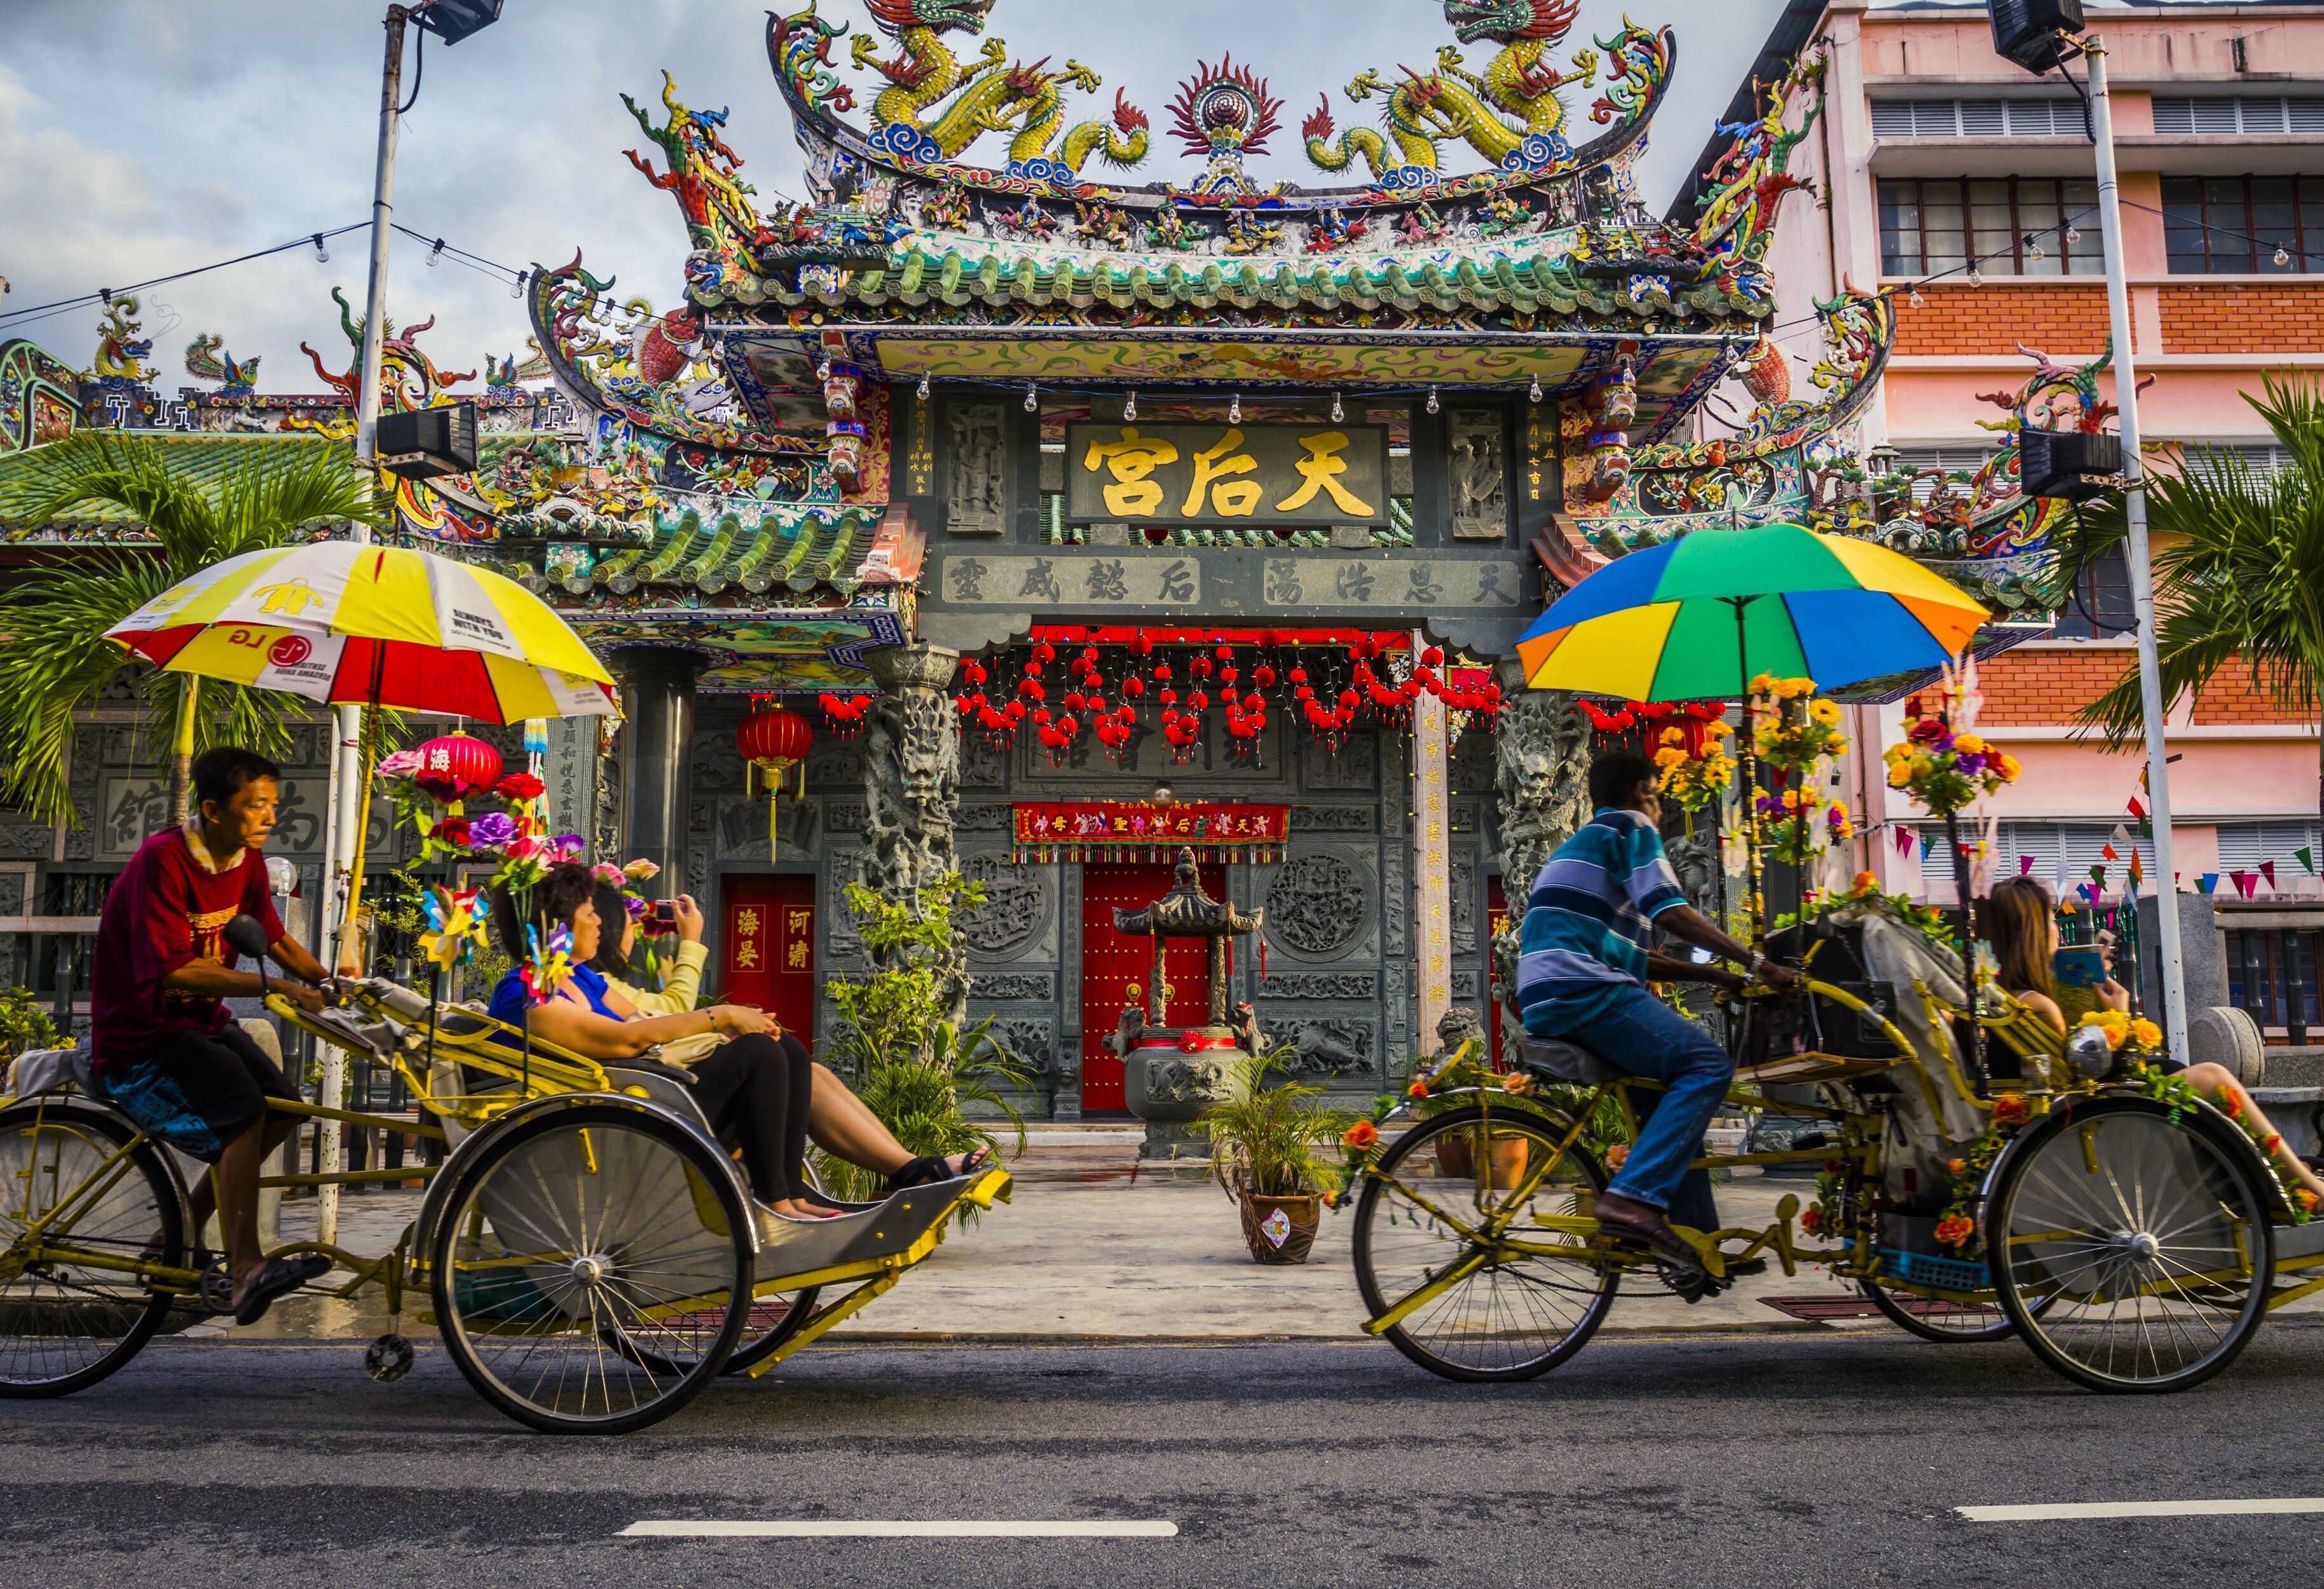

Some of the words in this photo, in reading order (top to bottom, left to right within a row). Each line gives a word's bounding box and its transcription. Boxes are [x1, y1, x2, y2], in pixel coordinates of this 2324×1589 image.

[1084, 426, 1374, 517] 天后宮
[1528, 408, 1541, 500] 正月廿七吉日
[1051, 815, 1251, 833] 天后聖母
[736, 908, 760, 968] 海晏
[789, 911, 810, 968] 河清
